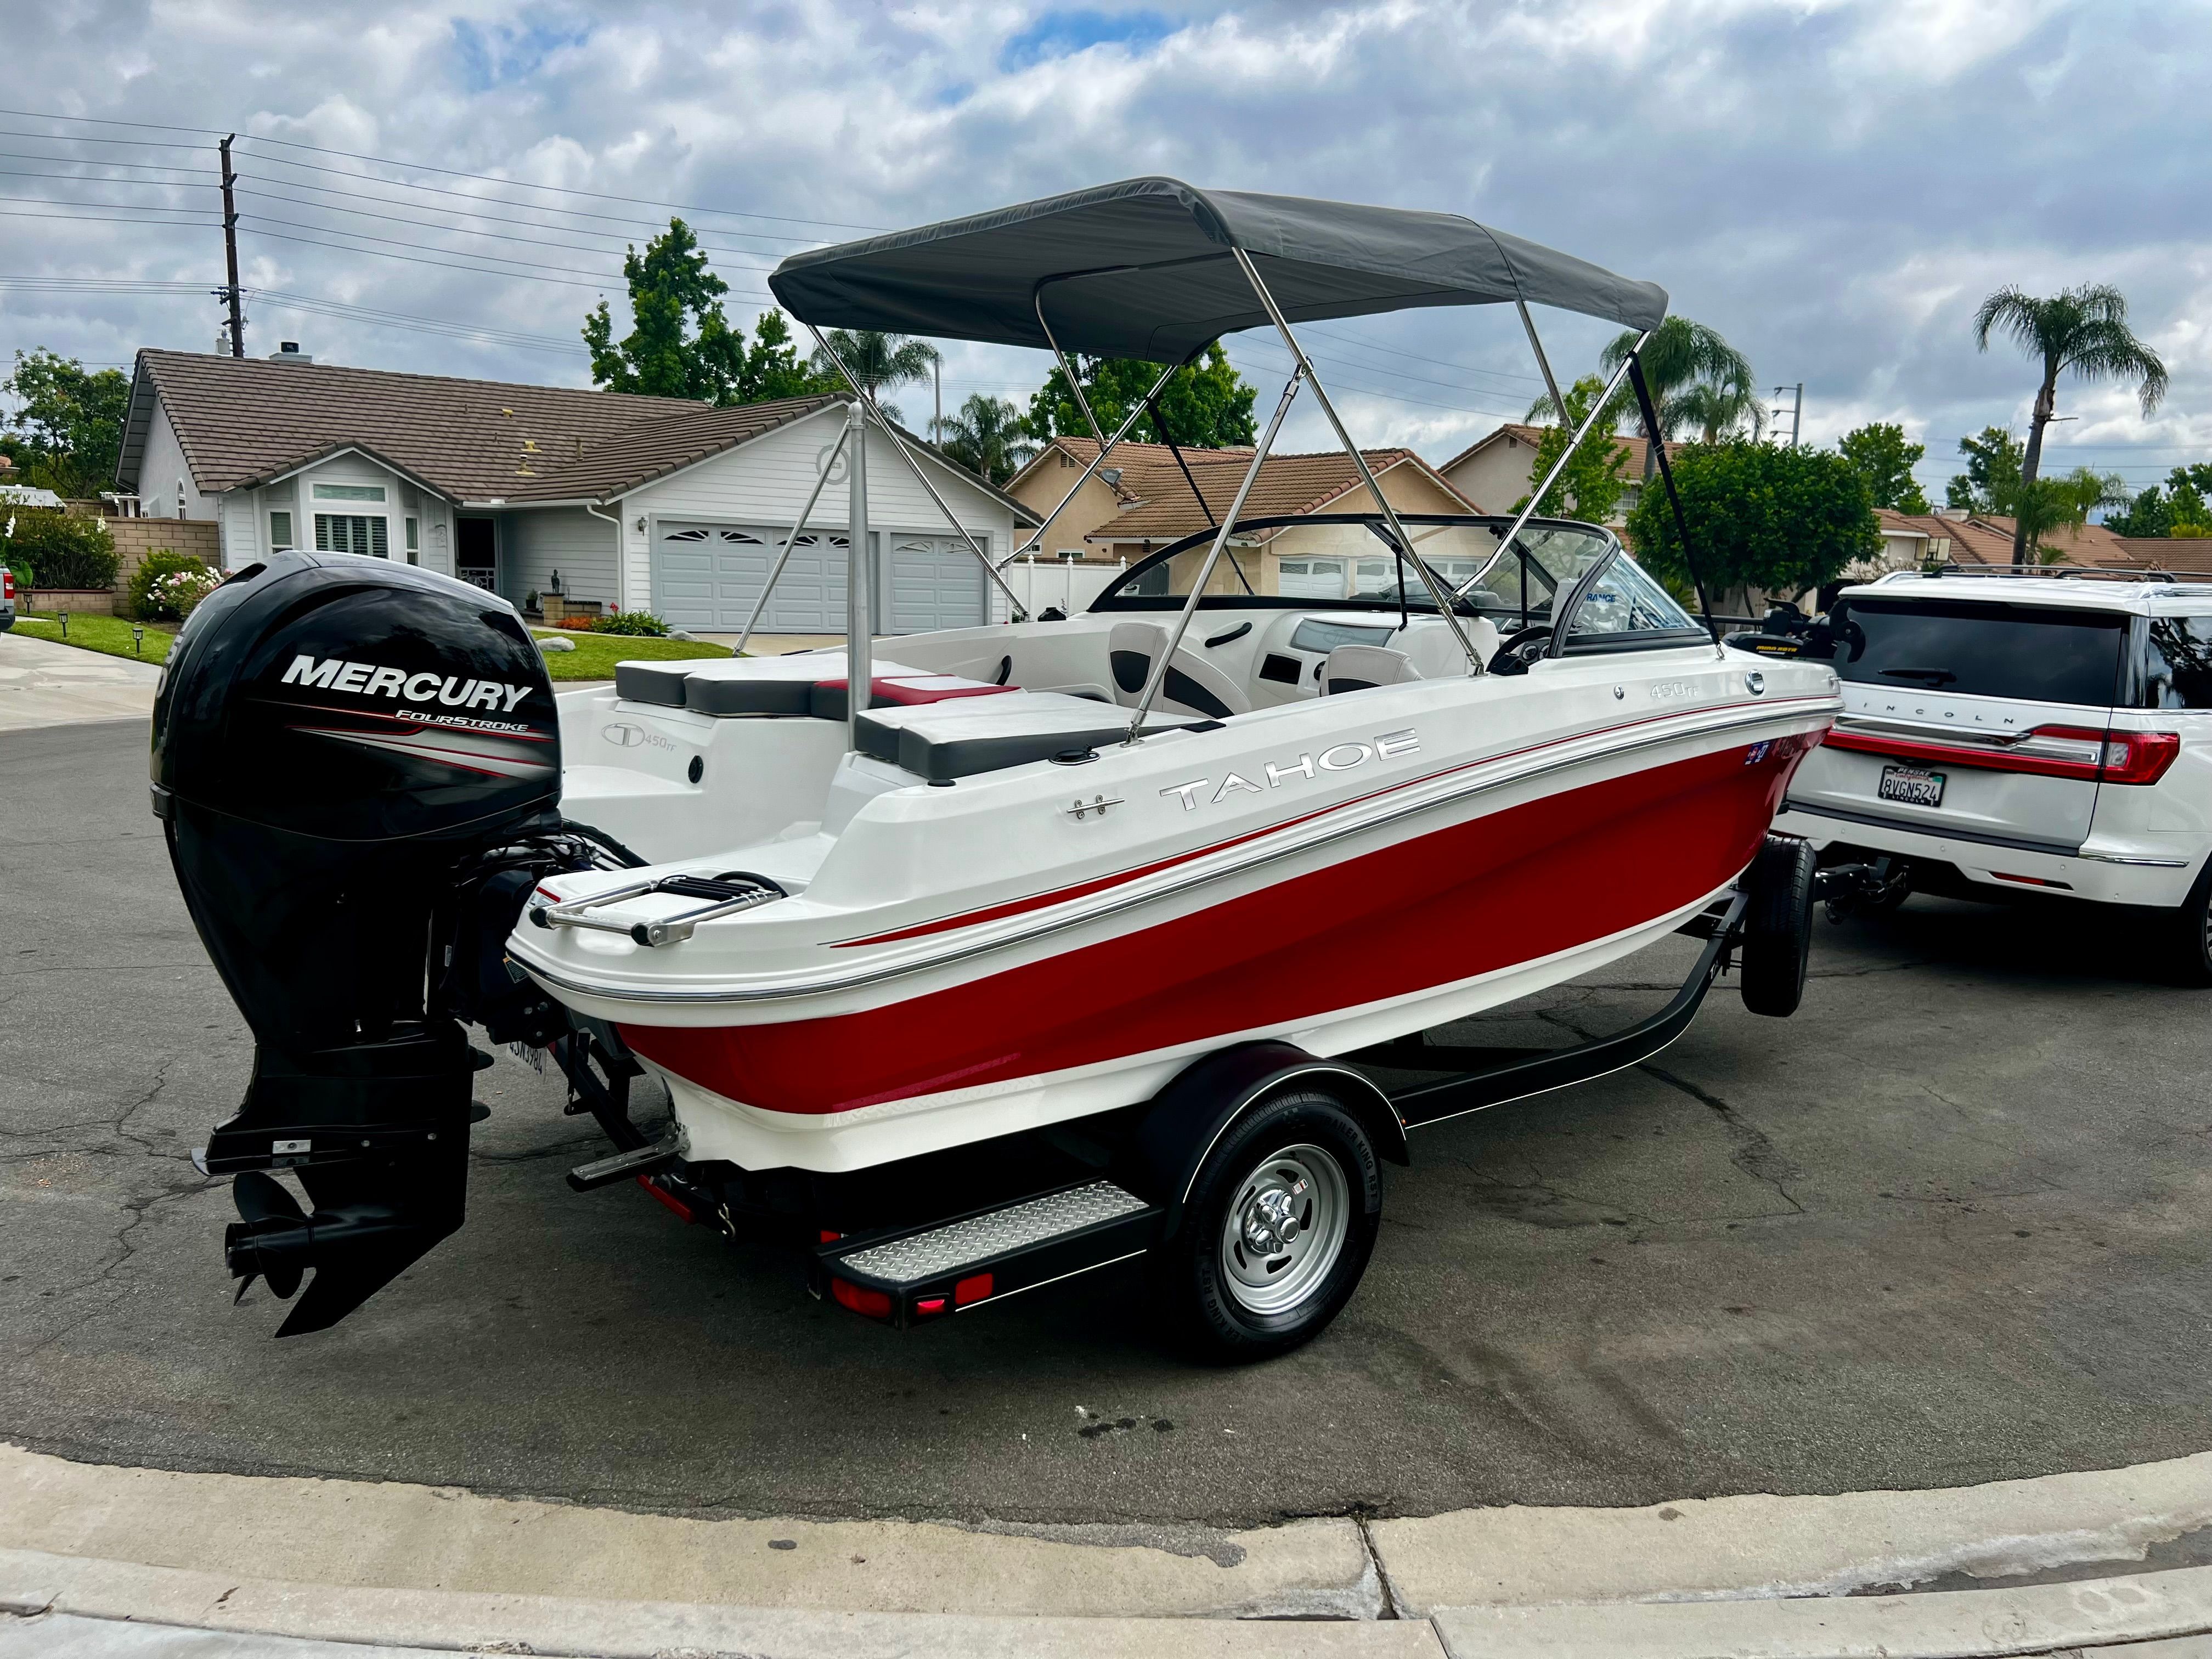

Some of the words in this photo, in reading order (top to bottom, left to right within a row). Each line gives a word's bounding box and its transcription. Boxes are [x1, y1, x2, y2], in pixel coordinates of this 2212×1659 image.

[281, 654, 533, 712] MERCURY
[1863, 702, 2014, 724] INCOLN
[1159, 727, 1421, 811] TAHOE
[1883, 778, 1937, 800] 8VGN524
[1356, 1140, 1373, 1171] KING
[1368, 1173, 1378, 1199] RST
